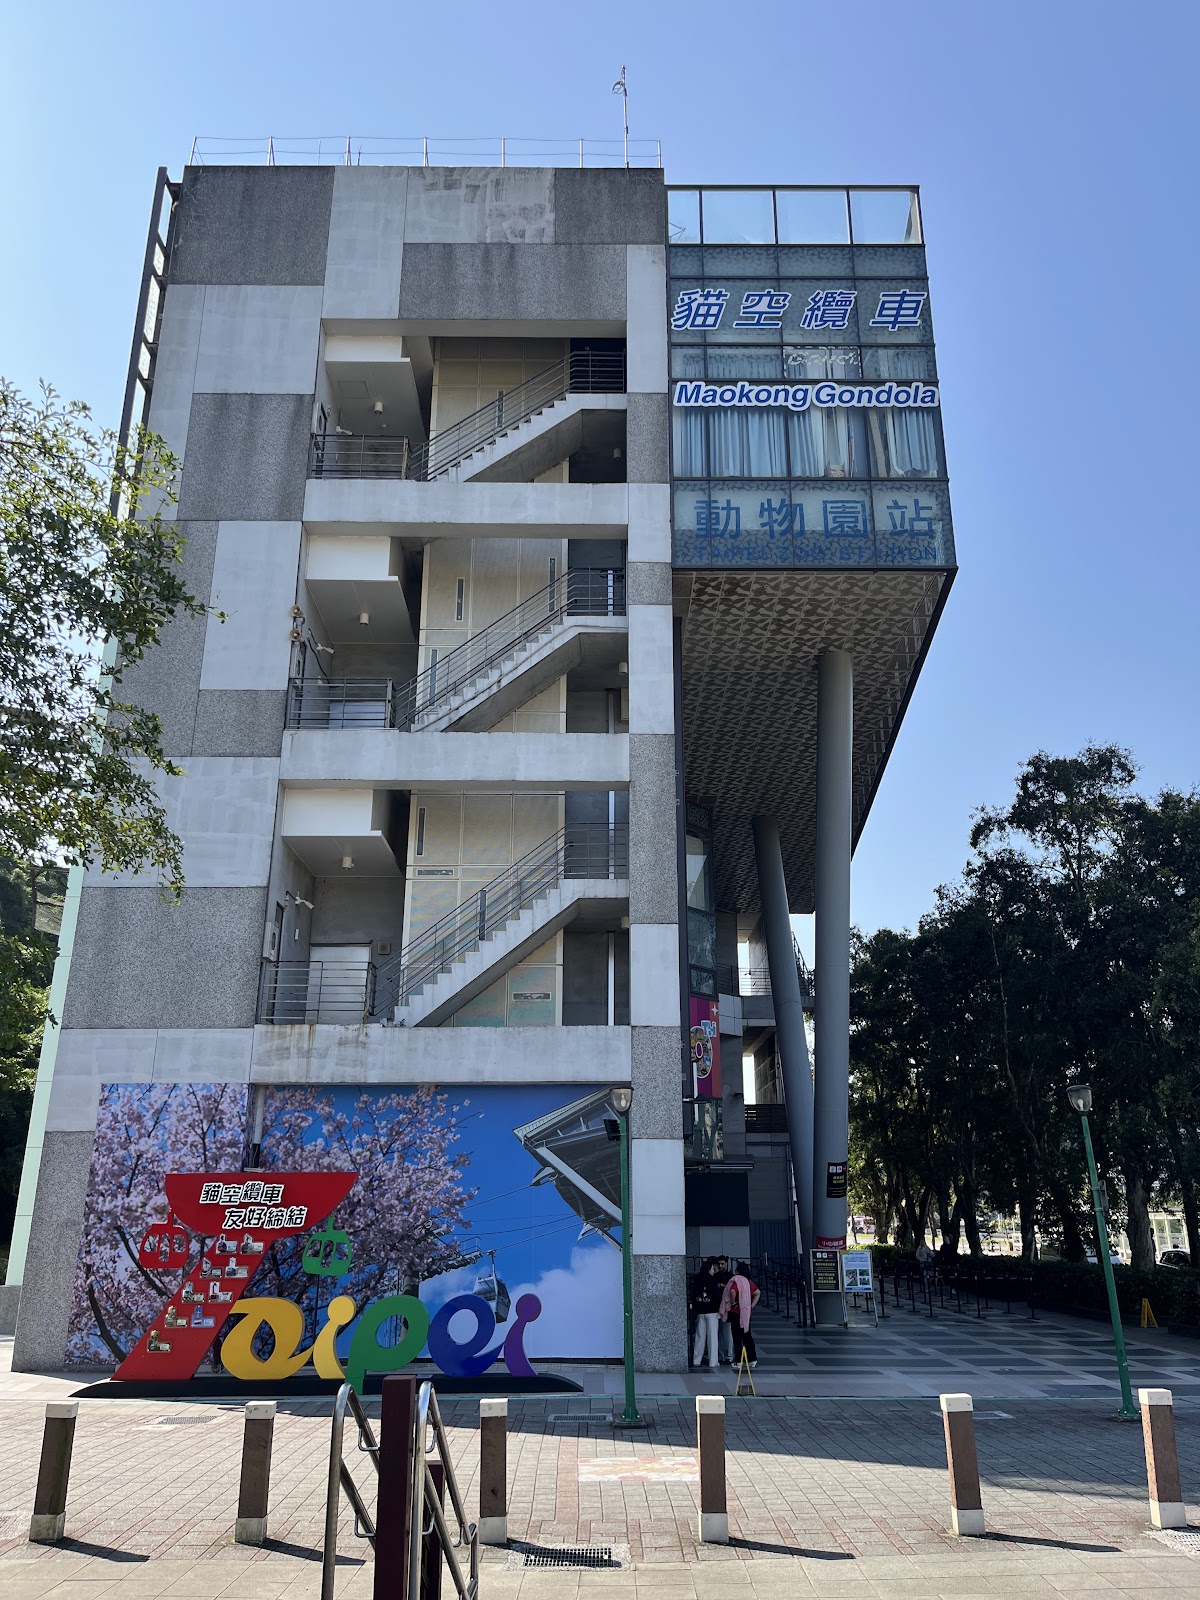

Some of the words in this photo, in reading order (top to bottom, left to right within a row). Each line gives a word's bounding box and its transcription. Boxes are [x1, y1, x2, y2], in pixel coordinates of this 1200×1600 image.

[671, 289, 927, 331] 貓空纜車
[673, 382, 811, 411] Maokong
[812, 382, 939, 408] Gondola
[694, 498, 933, 540] 動物園站
[199, 1181, 285, 1205] 貓空纜車
[222, 1206, 308, 1229] 友好締結
